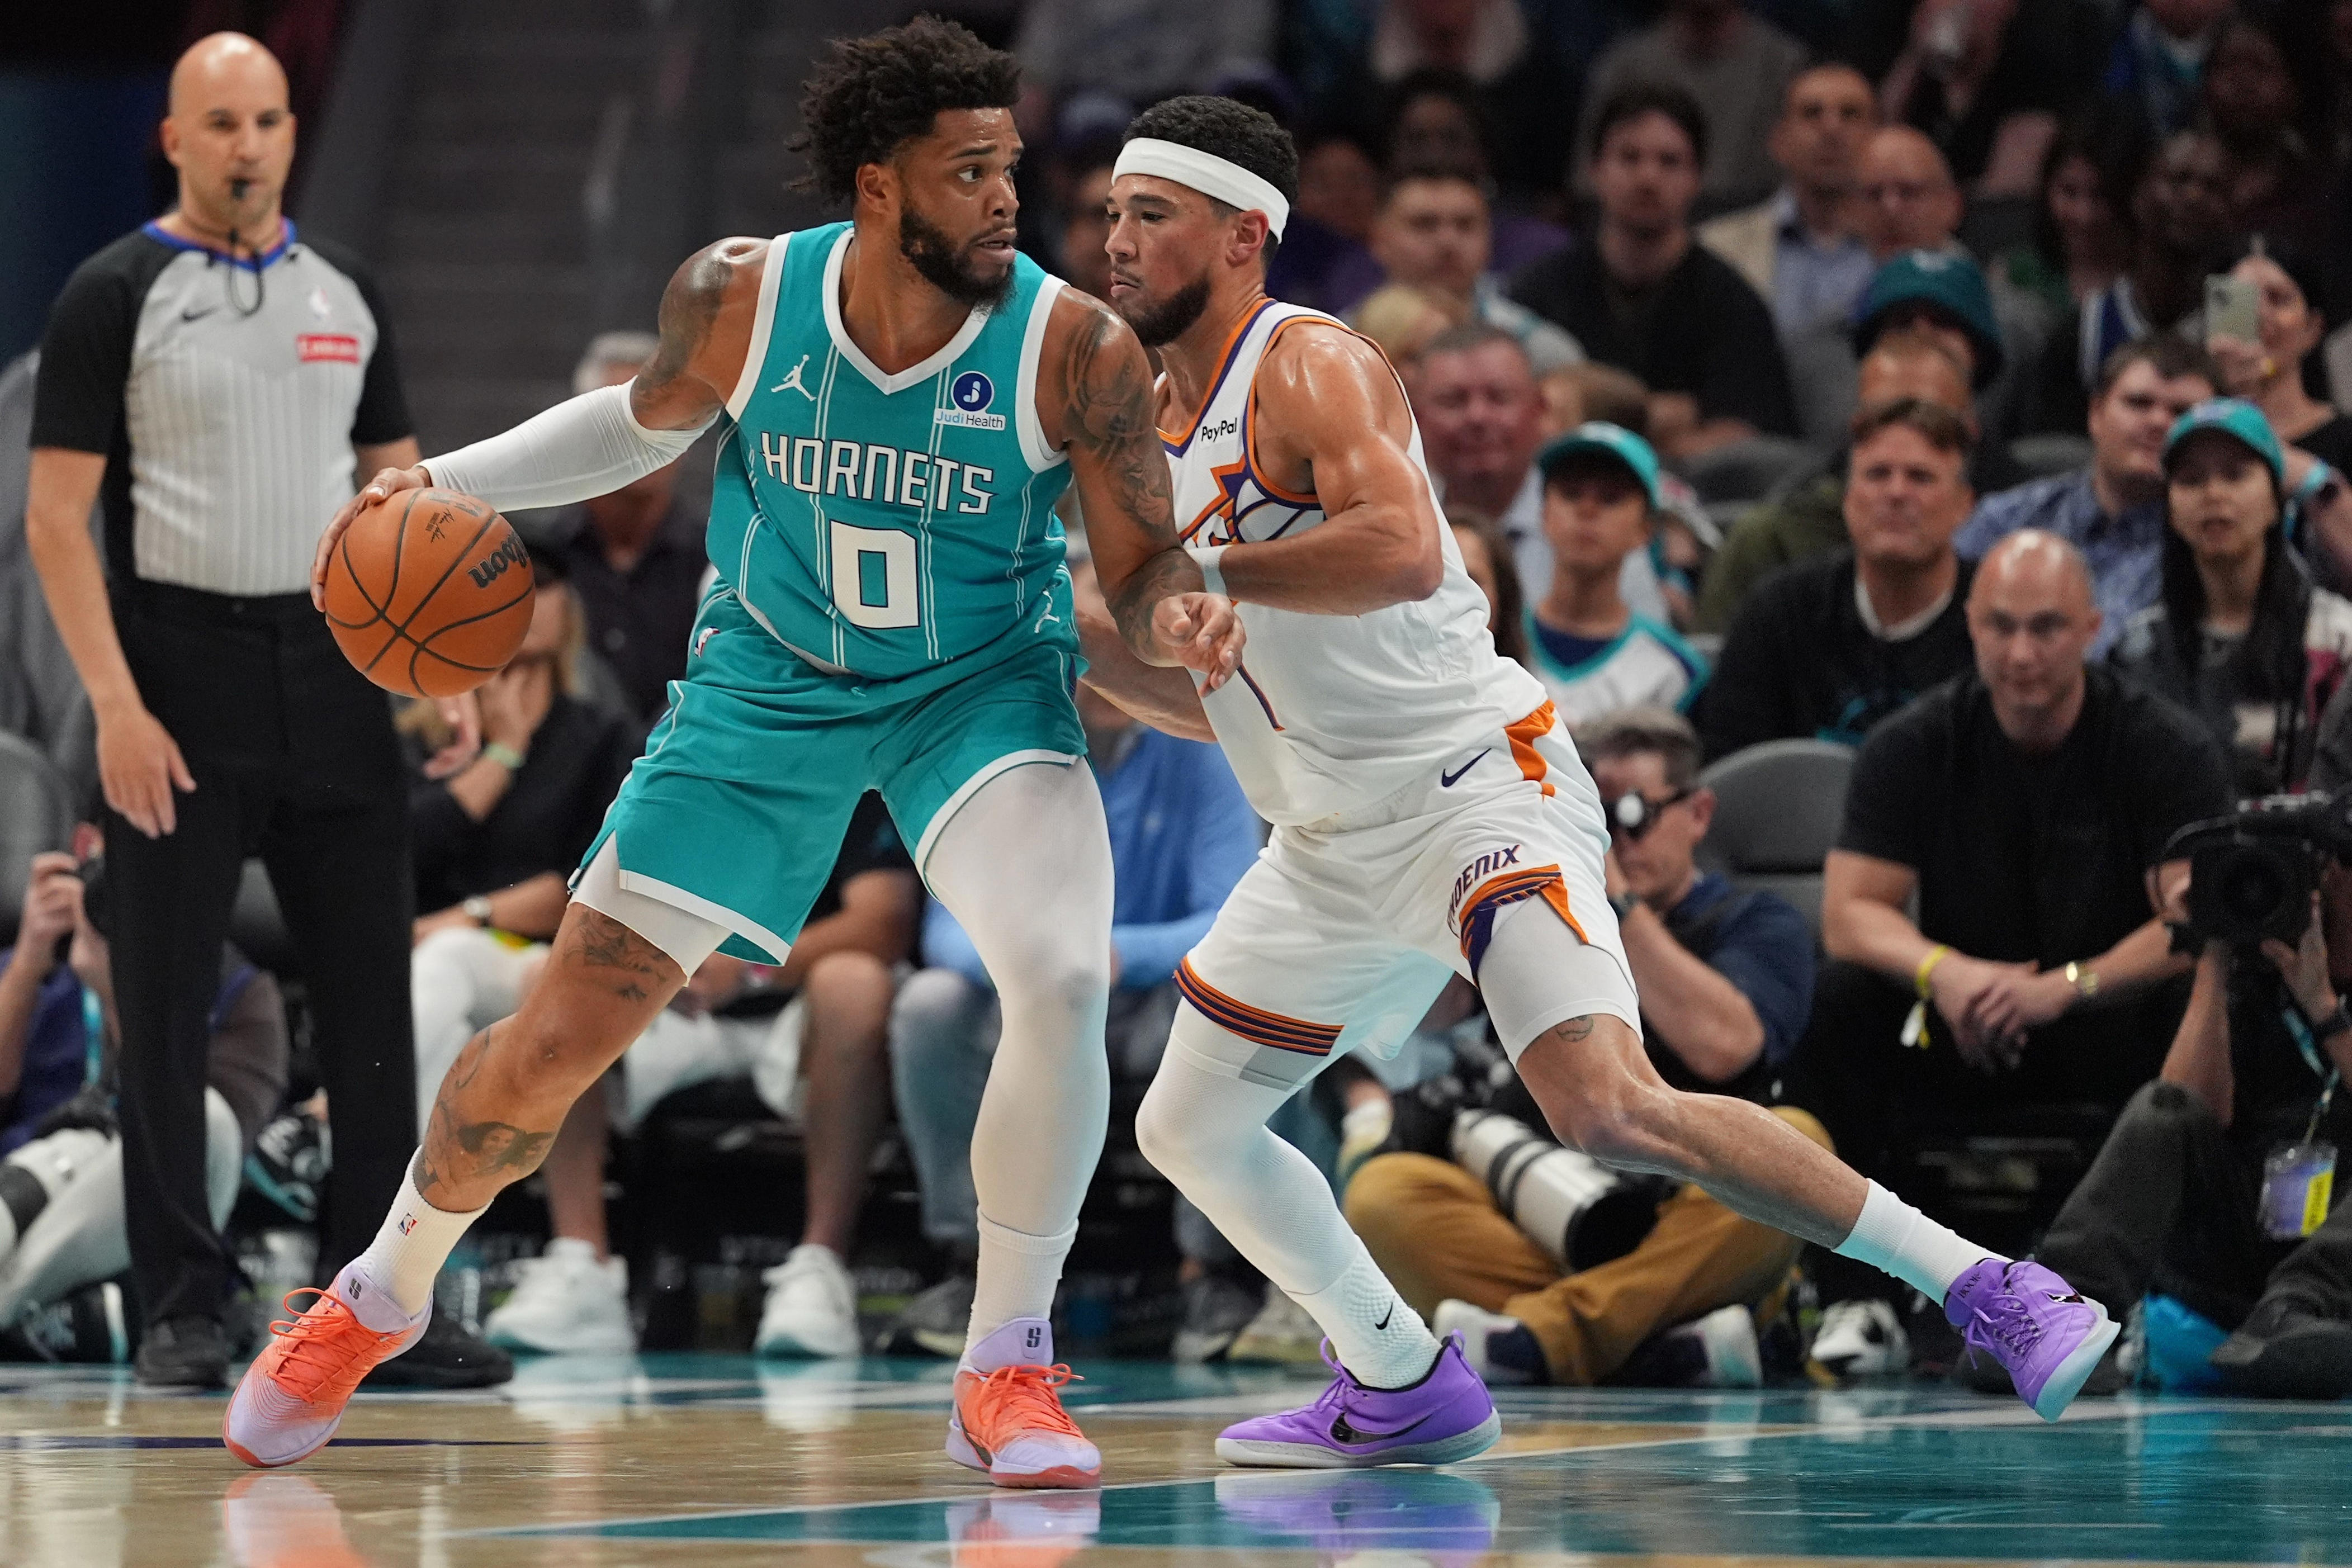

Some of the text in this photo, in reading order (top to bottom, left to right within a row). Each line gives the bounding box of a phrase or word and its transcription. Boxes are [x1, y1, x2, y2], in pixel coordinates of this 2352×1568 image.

[936, 411, 1004, 429] Judi Health
[1201, 416, 1237, 443] PayPal
[760, 431, 1000, 515] HORNETS
[467, 529, 529, 589] lson
[830, 518, 920, 630] 0
